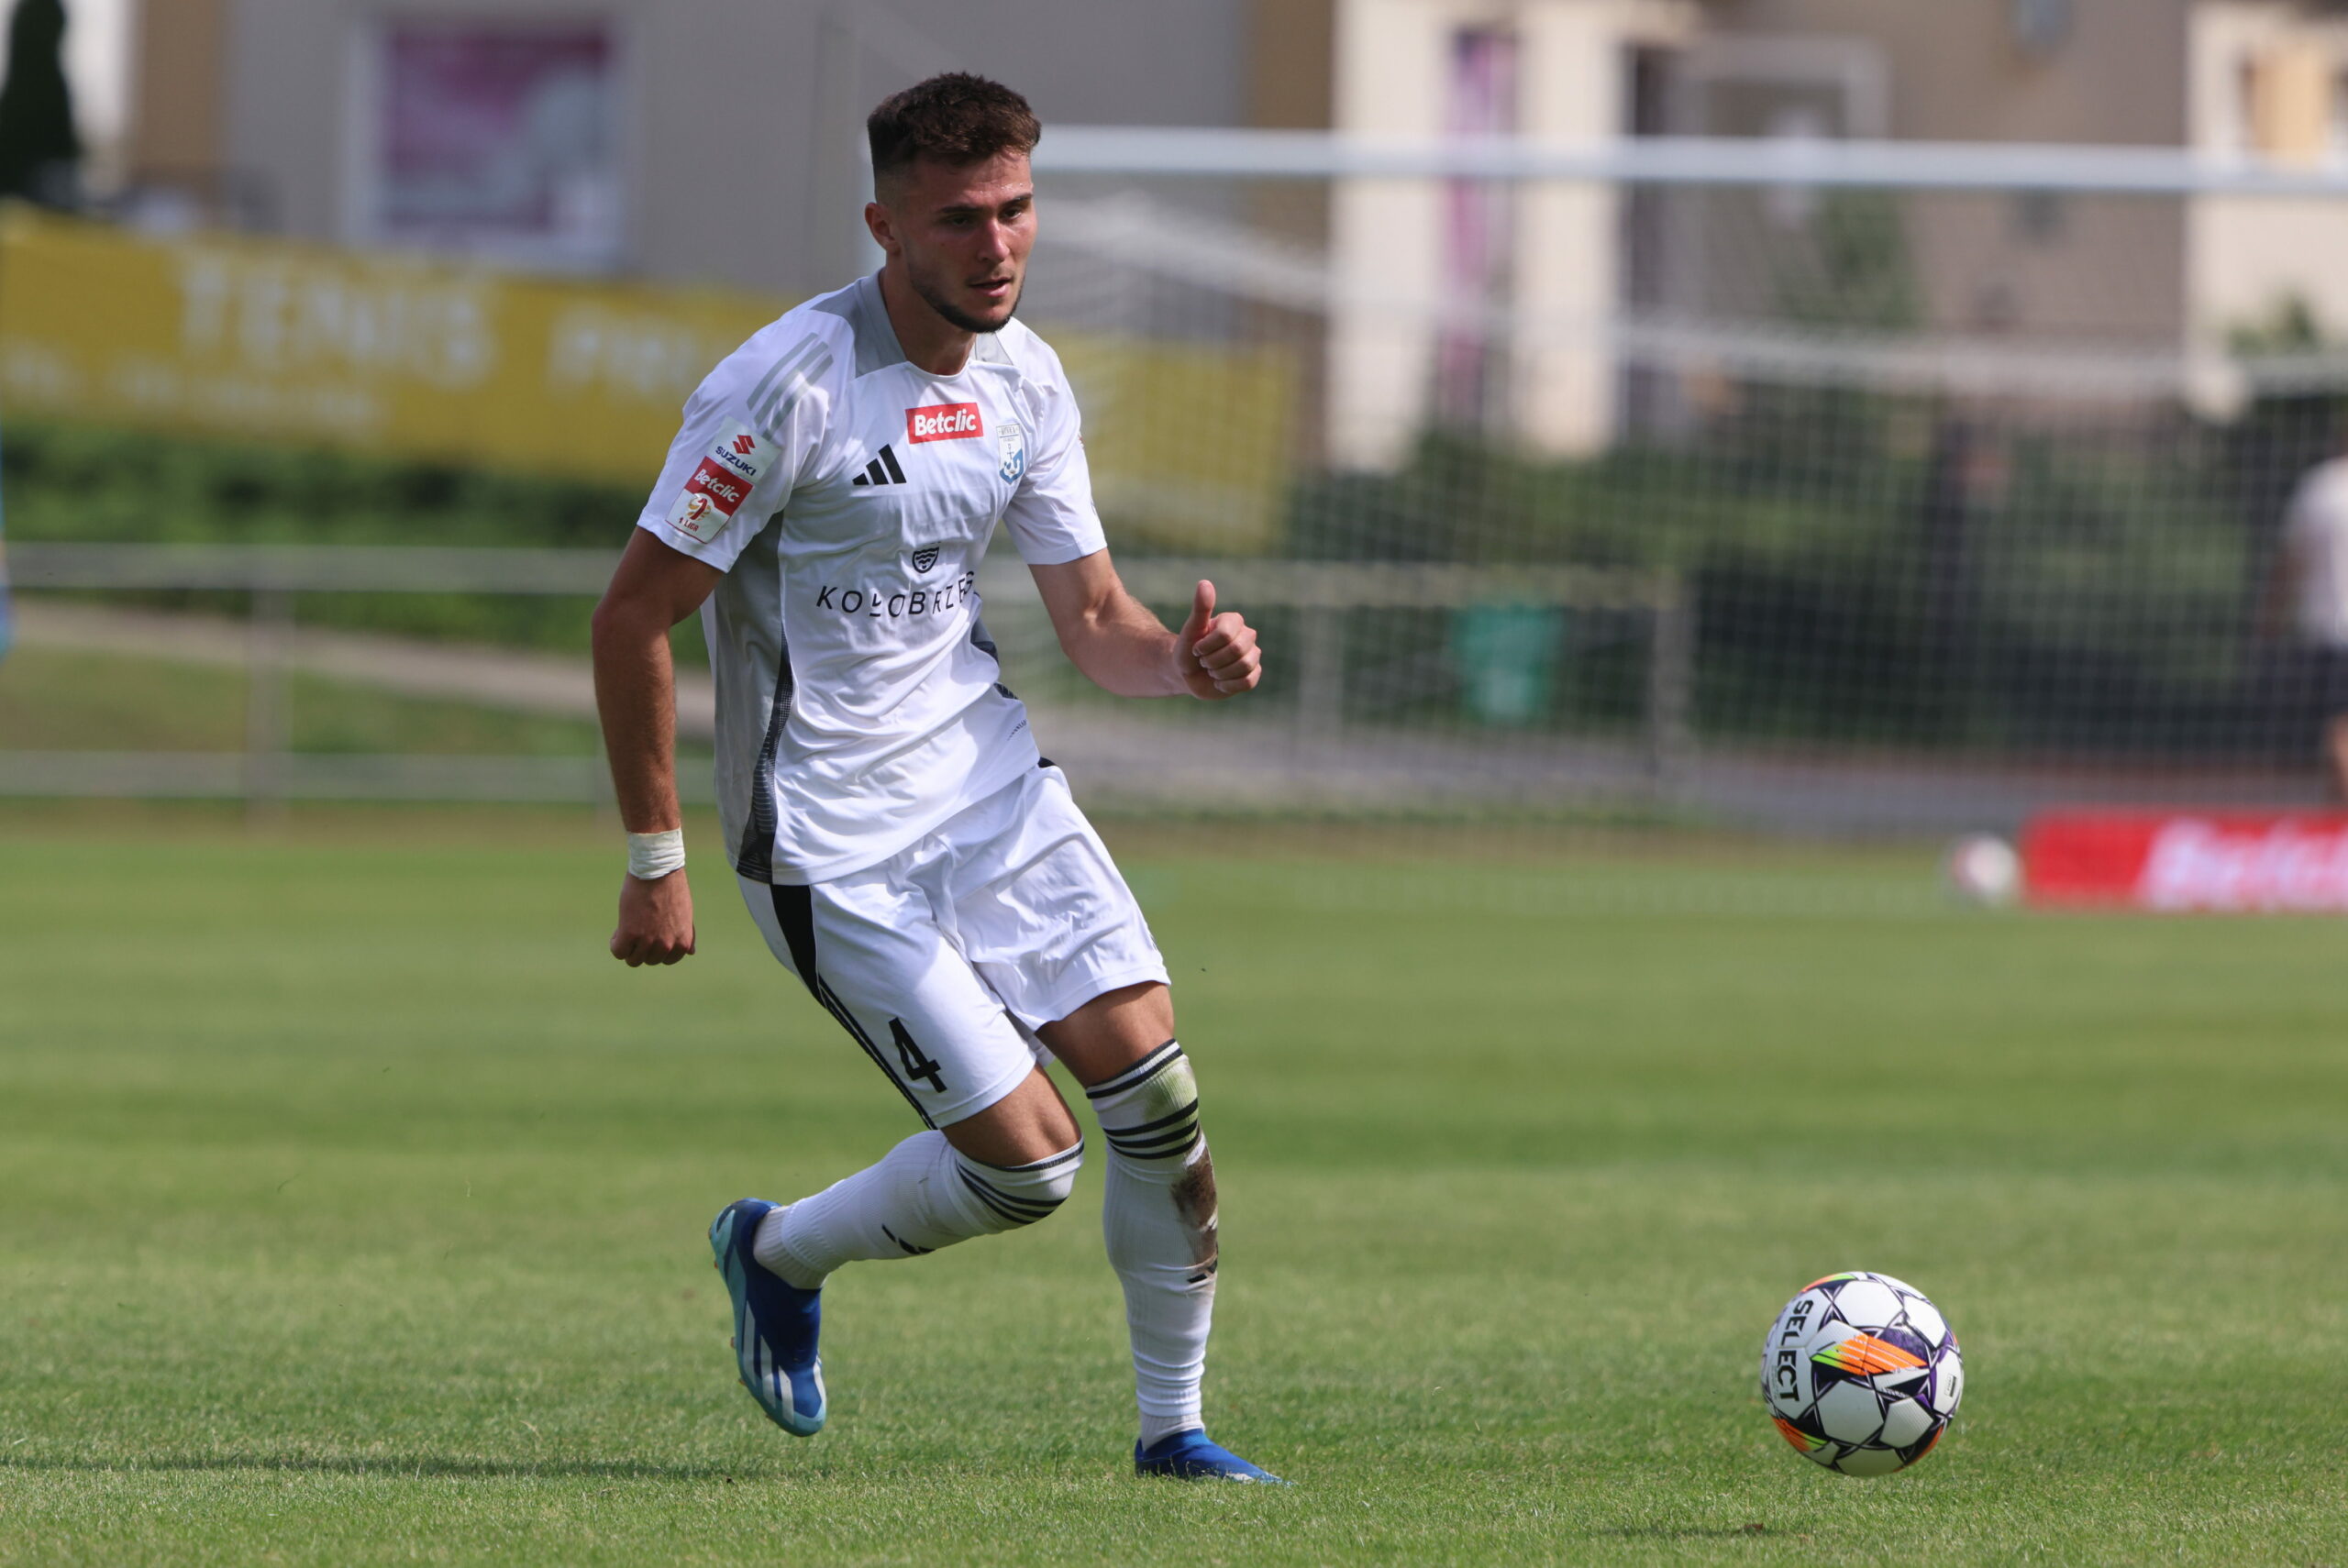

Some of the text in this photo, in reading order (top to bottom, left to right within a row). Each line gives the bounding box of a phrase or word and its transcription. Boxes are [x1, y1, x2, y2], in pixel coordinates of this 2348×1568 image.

[914, 409, 977, 437] Betclic
[715, 446, 758, 477] SUZUKI
[694, 469, 740, 503] Betclic
[888, 1017, 947, 1093] 4
[1778, 1299, 1814, 1402] SELECT
